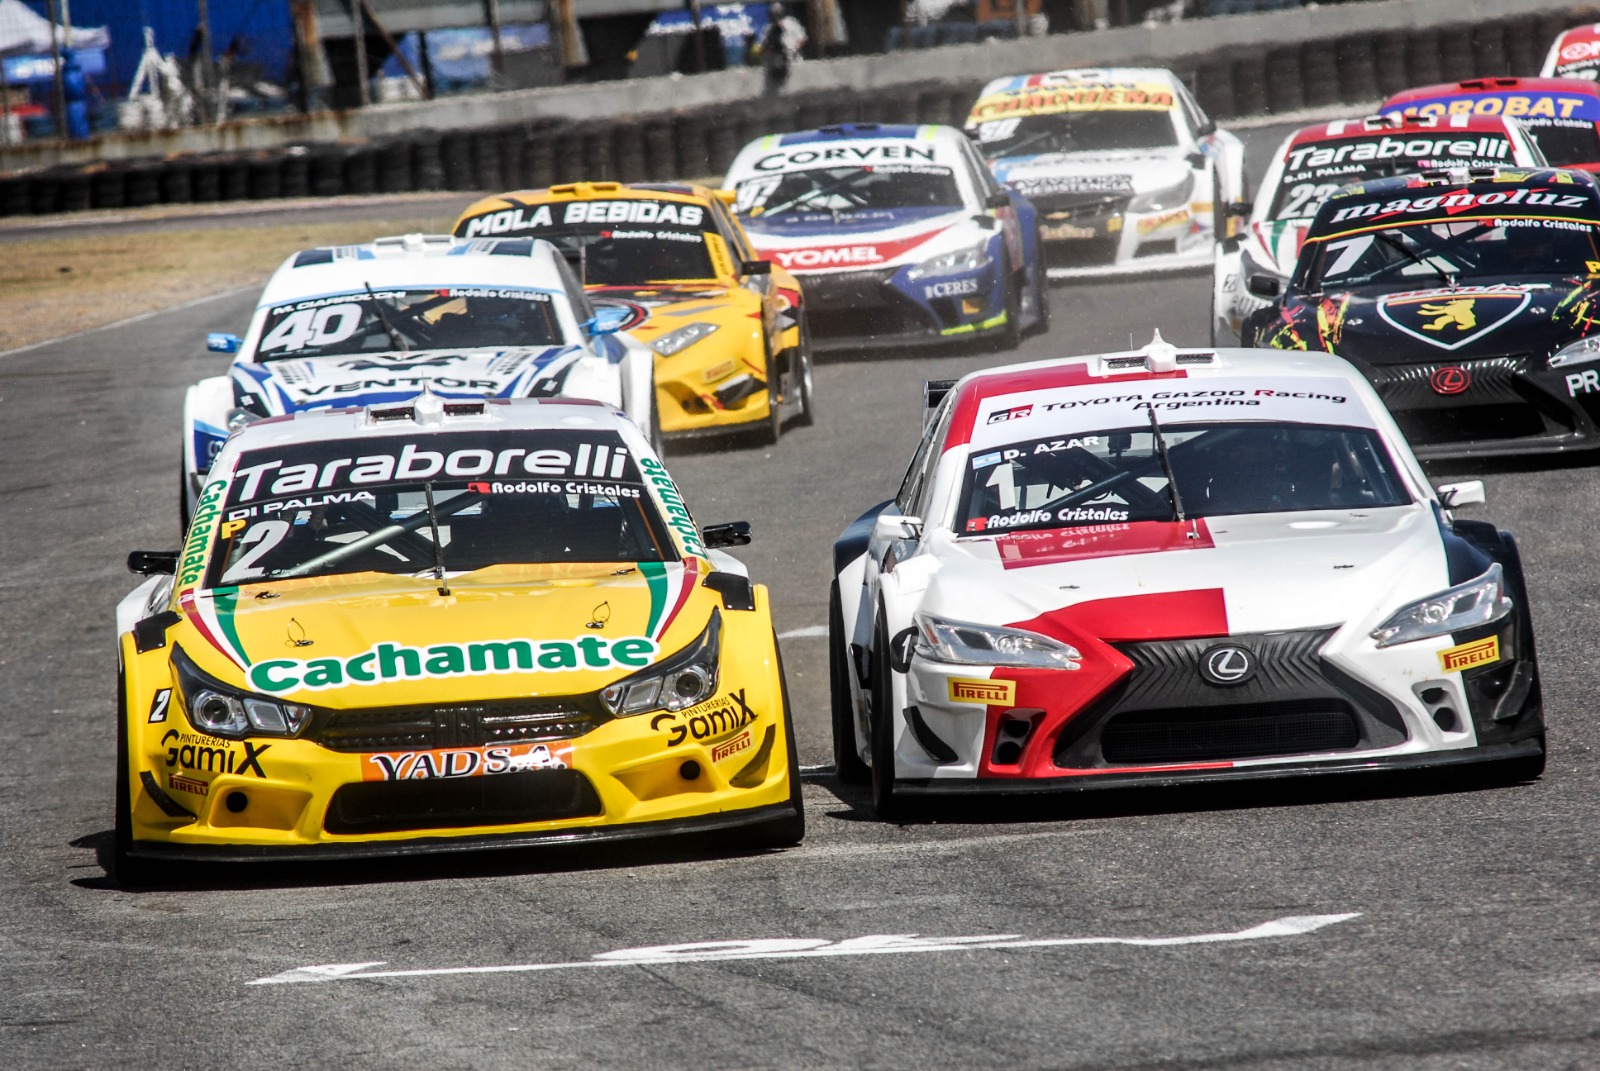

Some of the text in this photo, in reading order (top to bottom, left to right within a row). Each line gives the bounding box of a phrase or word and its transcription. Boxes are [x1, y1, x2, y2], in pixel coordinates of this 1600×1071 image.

[754, 145, 936, 171] CORVEN
[1289, 137, 1510, 171] Taraborelli
[1431, 158, 1470, 168] Rodolfo
[1316, 164, 1367, 177] PALMA
[465, 201, 704, 237] MOLA BEBIDAS
[1329, 188, 1589, 224] magnoluz
[612, 230, 702, 243] Rodolfo Cristales
[1493, 218, 1593, 232] Rodolfo Cristales
[775, 246, 884, 267] YOMEL
[1324, 233, 1376, 277] 7
[449, 288, 549, 302] Rodolfo Cristales
[259, 302, 363, 353] 40
[299, 376, 499, 396] VENTOR
[989, 388, 1347, 425] GR TOYOTA GAZOO Racing
[1132, 397, 1261, 411] Argentina
[1003, 436, 1100, 460] D. AZAR
[236, 443, 628, 502] Taraborelli
[985, 462, 1016, 511] 1
[491, 481, 641, 498] Rodolfo Cristales
[228, 491, 377, 522] DI PALMA
[987, 507, 1130, 529] Rodolfo Cristales
[221, 519, 247, 540] P
[220, 520, 290, 583] 2
[249, 635, 656, 693] Cachamate
[1443, 640, 1496, 671] PIRELLI
[150, 688, 171, 722] 2
[952, 681, 1008, 702] PIRELLI
[650, 687, 759, 748] GamiX
[160, 728, 273, 779] GamiX
[711, 731, 751, 763] PIRELLI
[168, 773, 209, 797] PIRELLI
